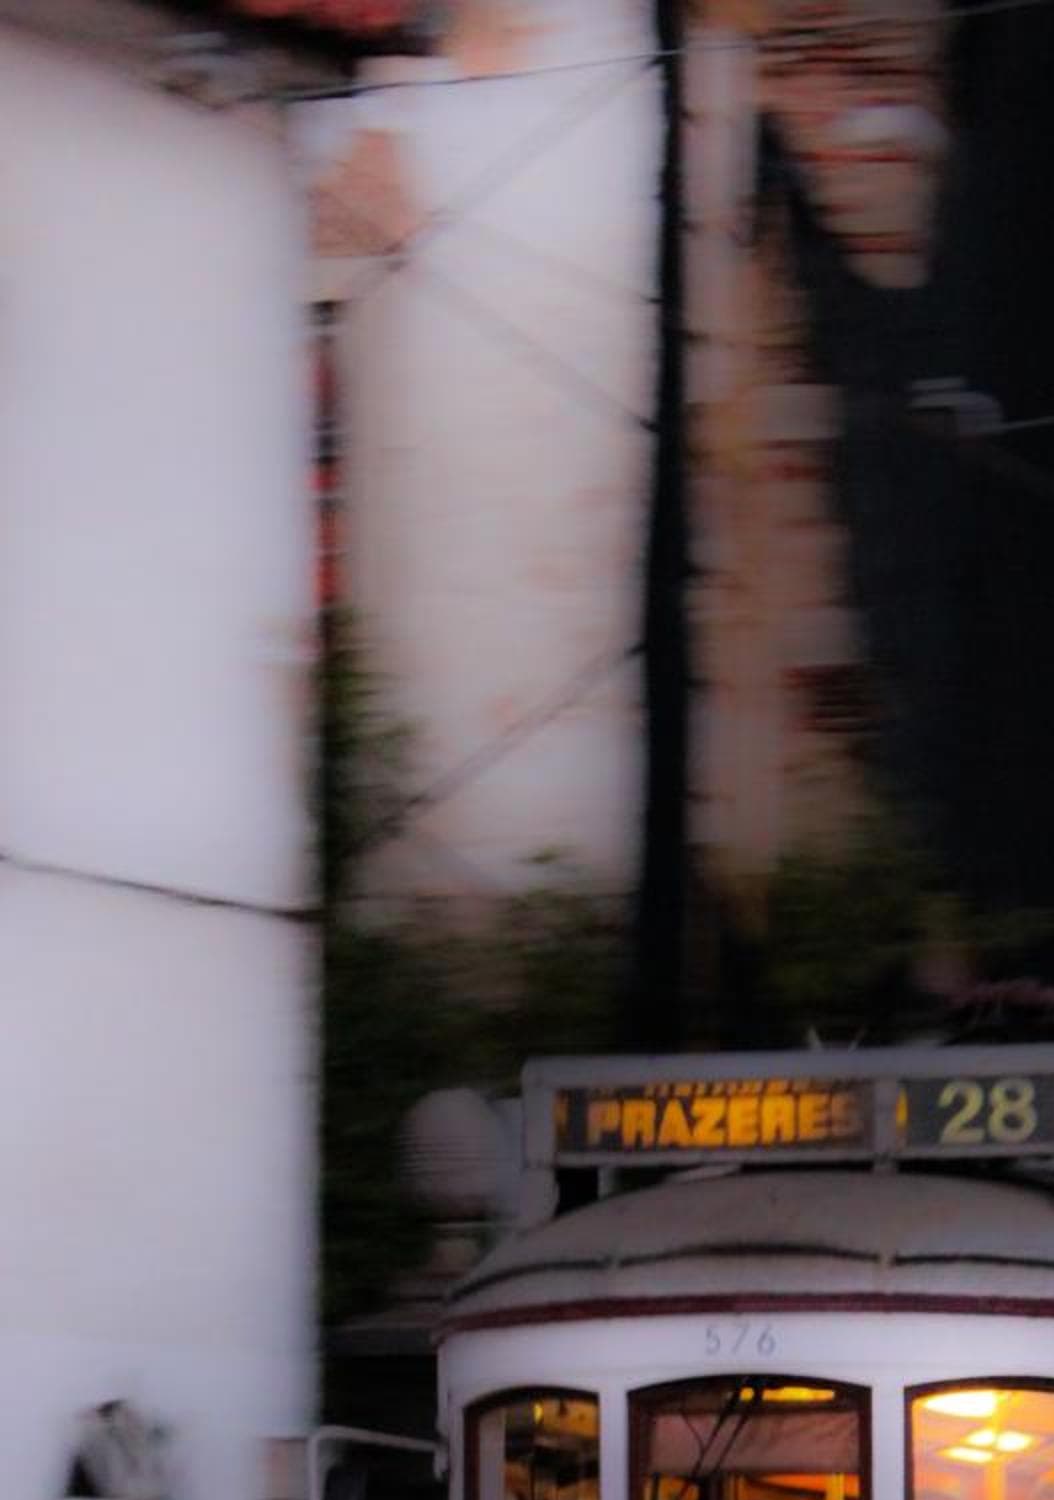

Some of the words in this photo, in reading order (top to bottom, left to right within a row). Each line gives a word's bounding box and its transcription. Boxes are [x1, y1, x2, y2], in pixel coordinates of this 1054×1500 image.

[588, 1094, 860, 1147] PRAZERES
[938, 1078, 1038, 1145] 28
[705, 1322, 777, 1356] 576
